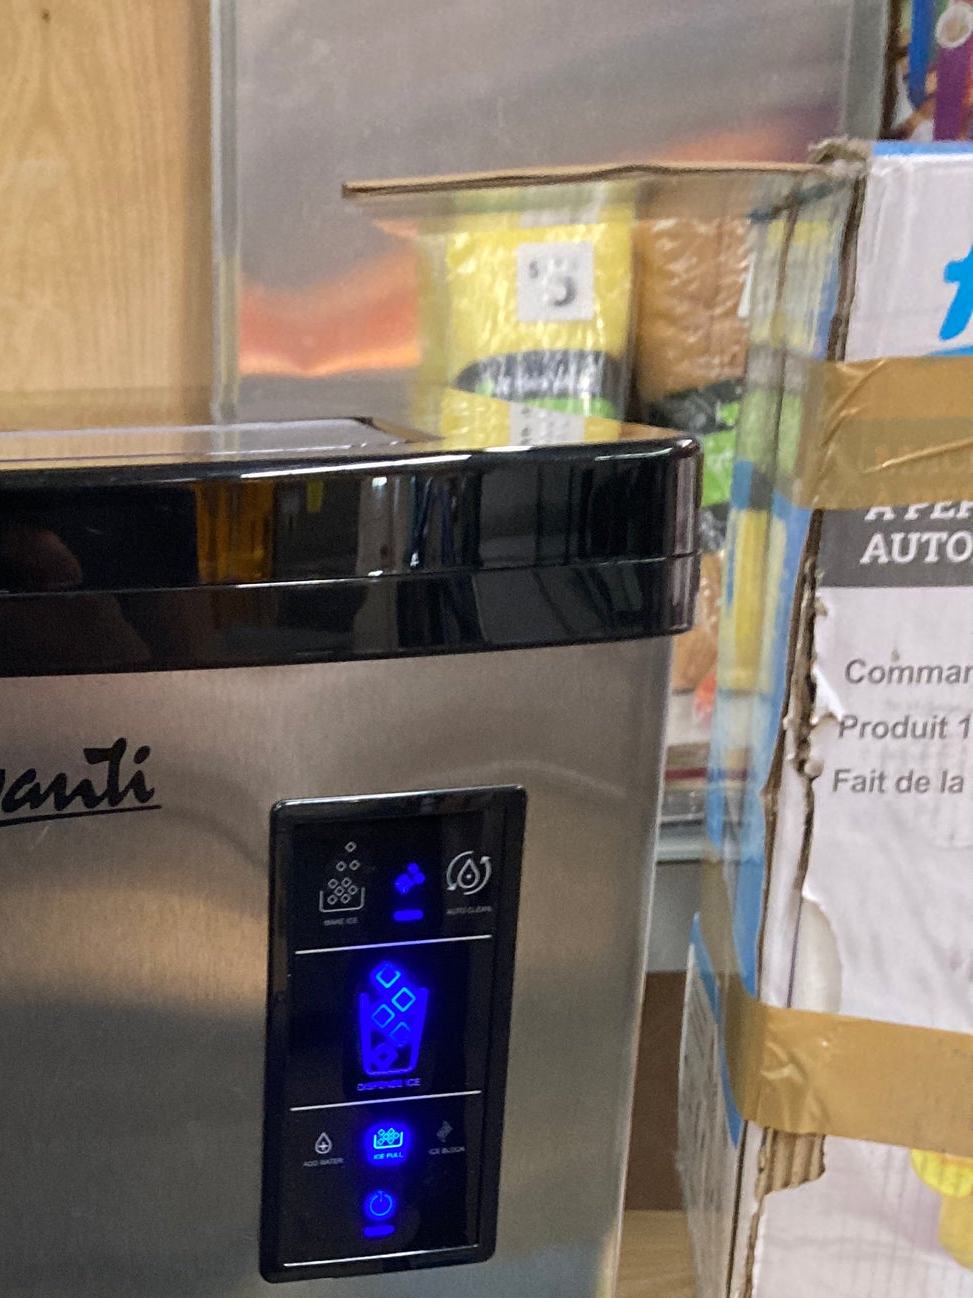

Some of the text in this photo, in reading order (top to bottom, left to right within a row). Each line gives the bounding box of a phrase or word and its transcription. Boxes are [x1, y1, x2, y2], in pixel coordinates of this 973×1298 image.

[837, 714, 948, 740] Produit
[832, 768, 965, 794] Fait de la
[386, 1151, 404, 1159] FULL
